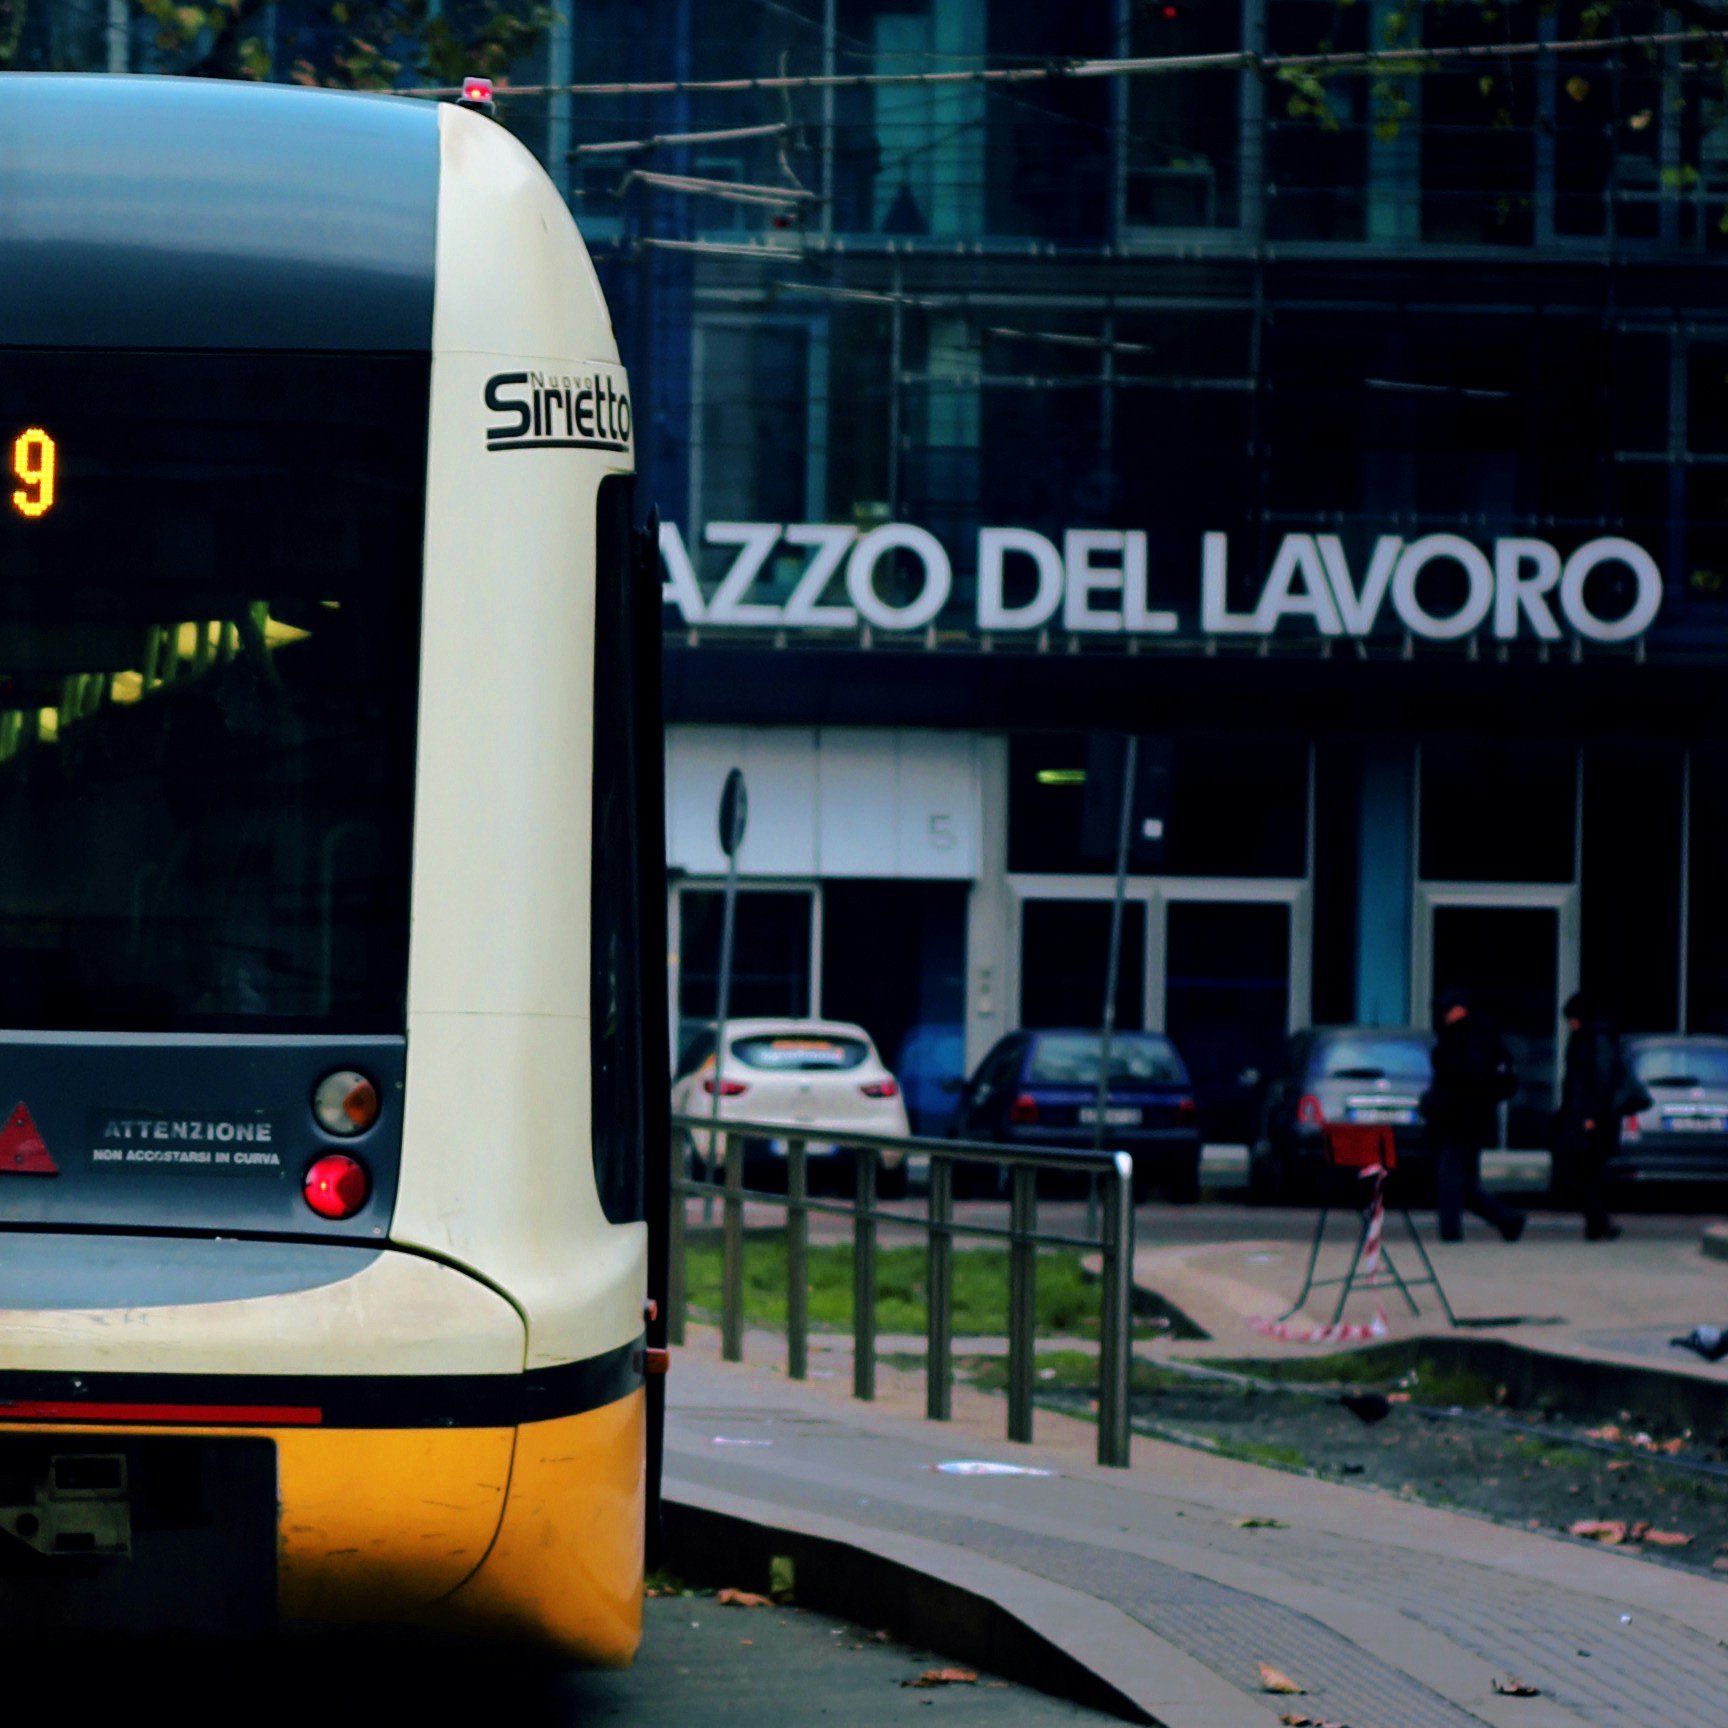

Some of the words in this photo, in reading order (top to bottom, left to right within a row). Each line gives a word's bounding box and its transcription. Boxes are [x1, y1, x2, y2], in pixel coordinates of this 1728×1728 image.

[530, 371, 593, 389] Nuovo
[484, 371, 630, 441] Sirietto
[13, 427, 56, 517] 9
[977, 527, 1178, 632] DEL
[1202, 531, 1664, 641] LAVORO
[928, 814, 959, 853] 5
[104, 1121, 272, 1142] ATTENZIONE
[93, 1149, 122, 1161] NON
[126, 1149, 211, 1163] ACCOSTARSI
[216, 1152, 230, 1163] IN
[234, 1152, 281, 1165] CURVA
